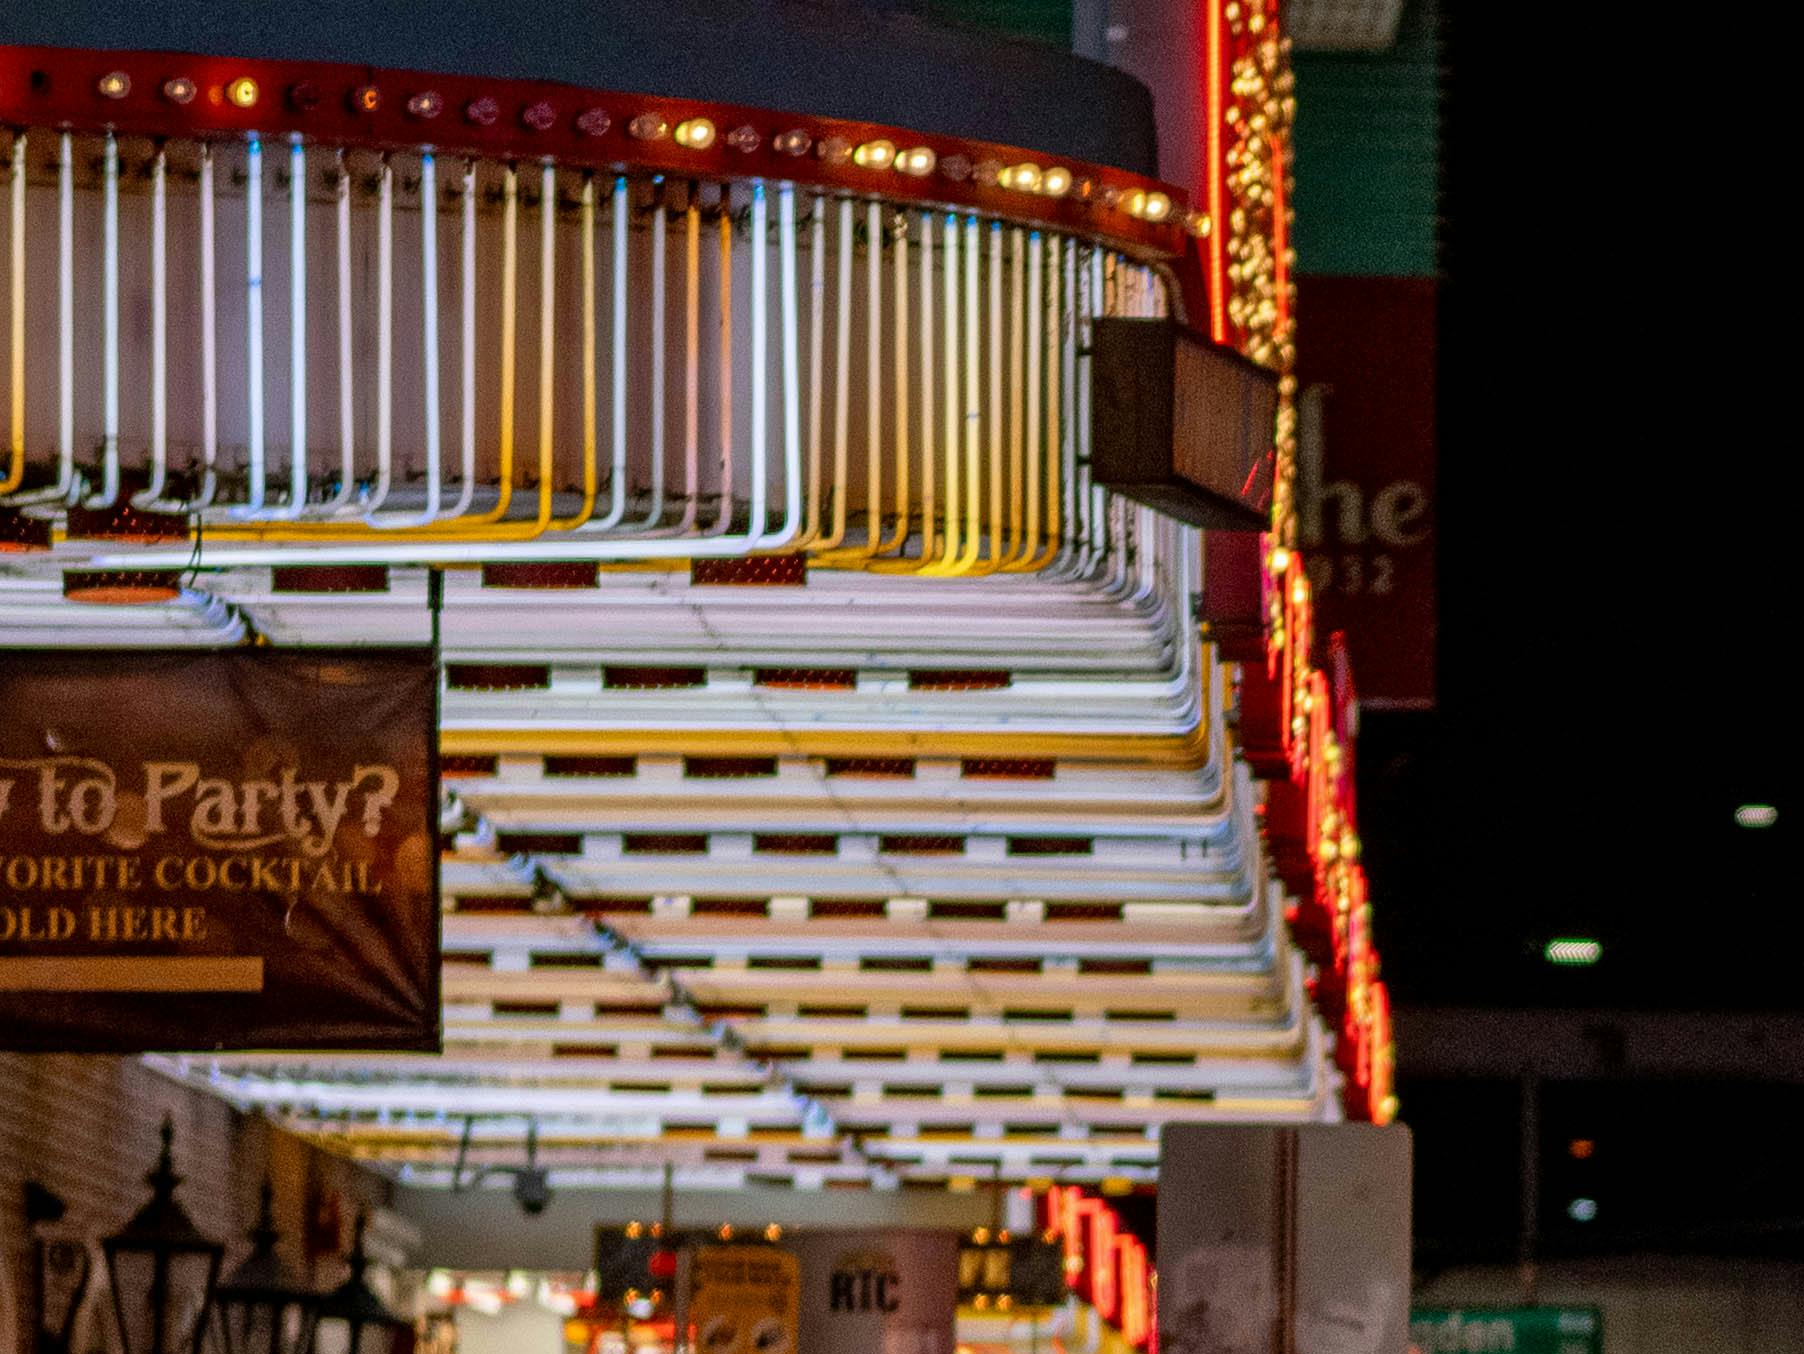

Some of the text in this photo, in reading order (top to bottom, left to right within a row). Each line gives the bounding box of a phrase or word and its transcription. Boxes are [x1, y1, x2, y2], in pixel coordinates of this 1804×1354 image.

[39, 757, 117, 835] to
[143, 761, 400, 857] Party?
[0, 855, 382, 893] ORITE COCKTAIL
[89, 906, 206, 942] HERE
